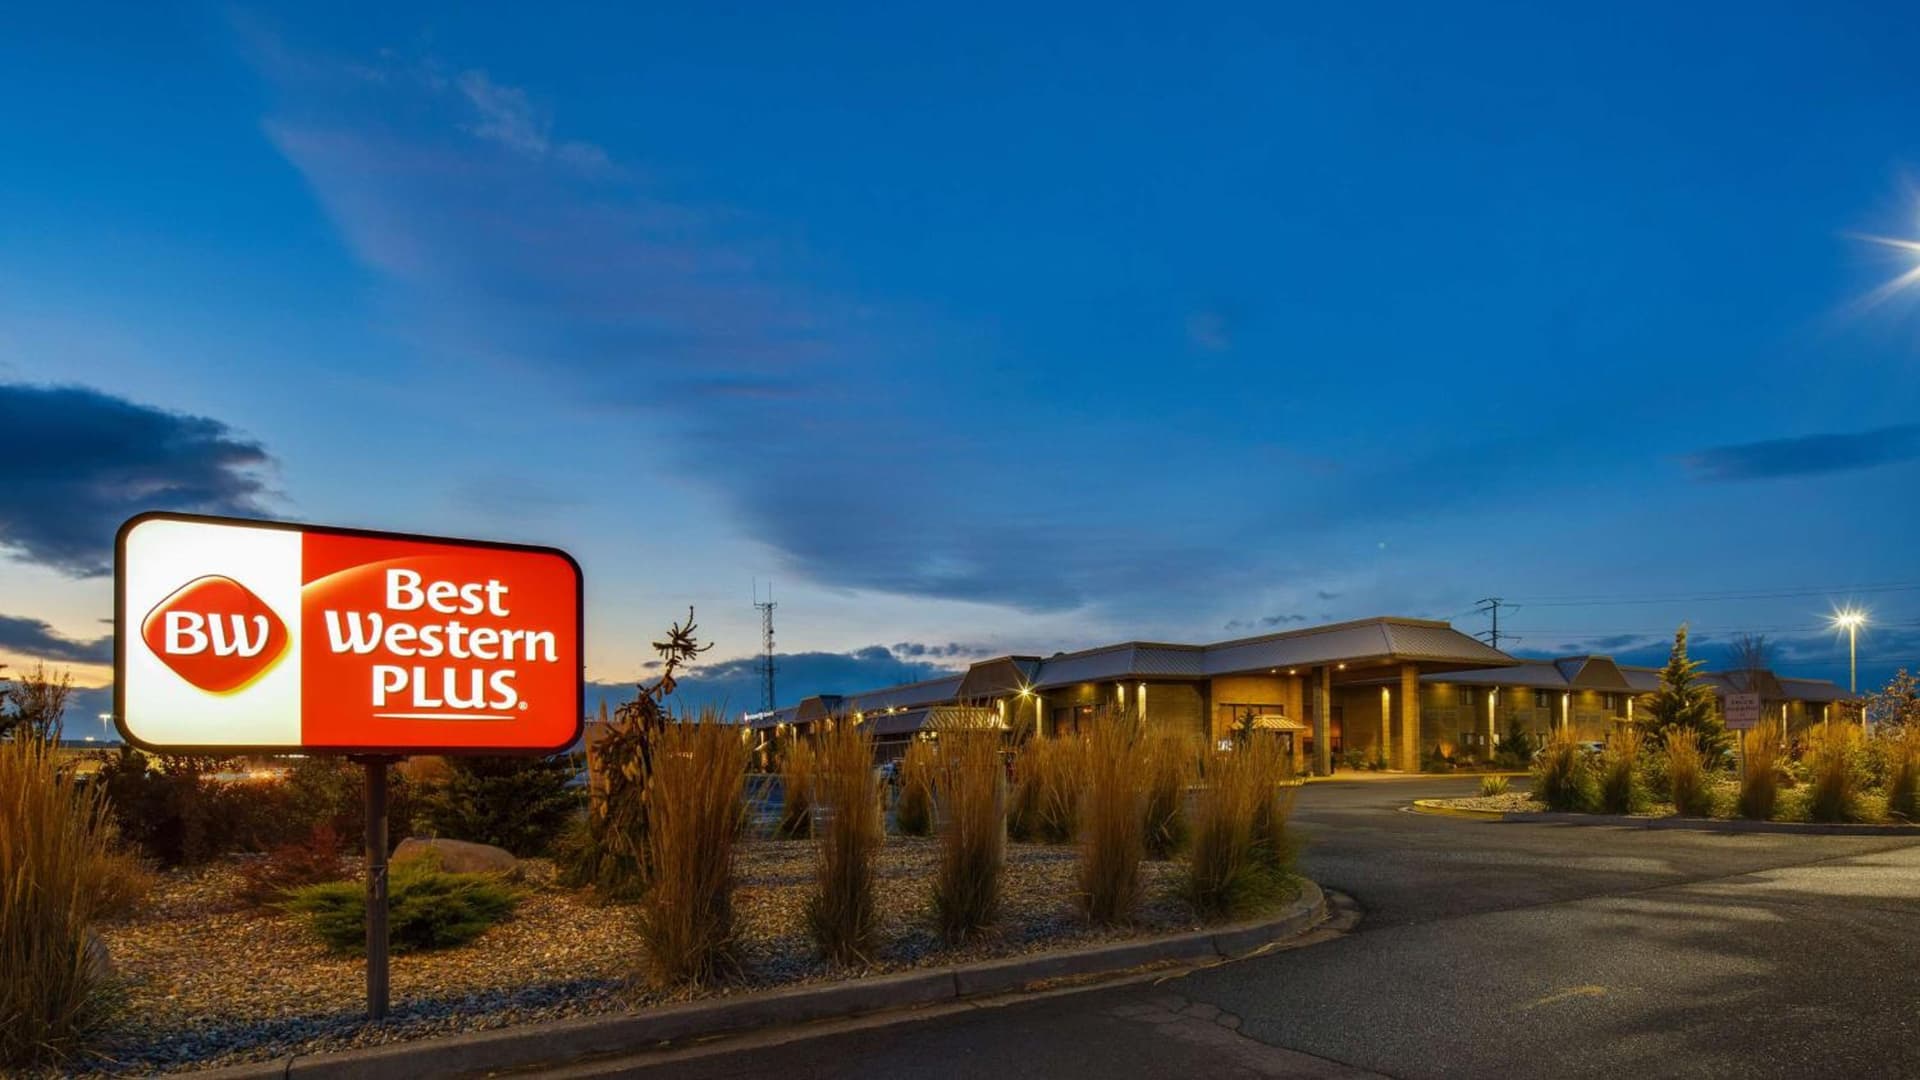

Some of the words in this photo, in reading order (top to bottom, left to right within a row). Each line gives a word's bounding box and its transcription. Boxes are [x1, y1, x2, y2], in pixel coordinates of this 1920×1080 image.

[386, 568, 510, 617] Best
[164, 610, 270, 657] BW
[324, 610, 558, 662] Western
